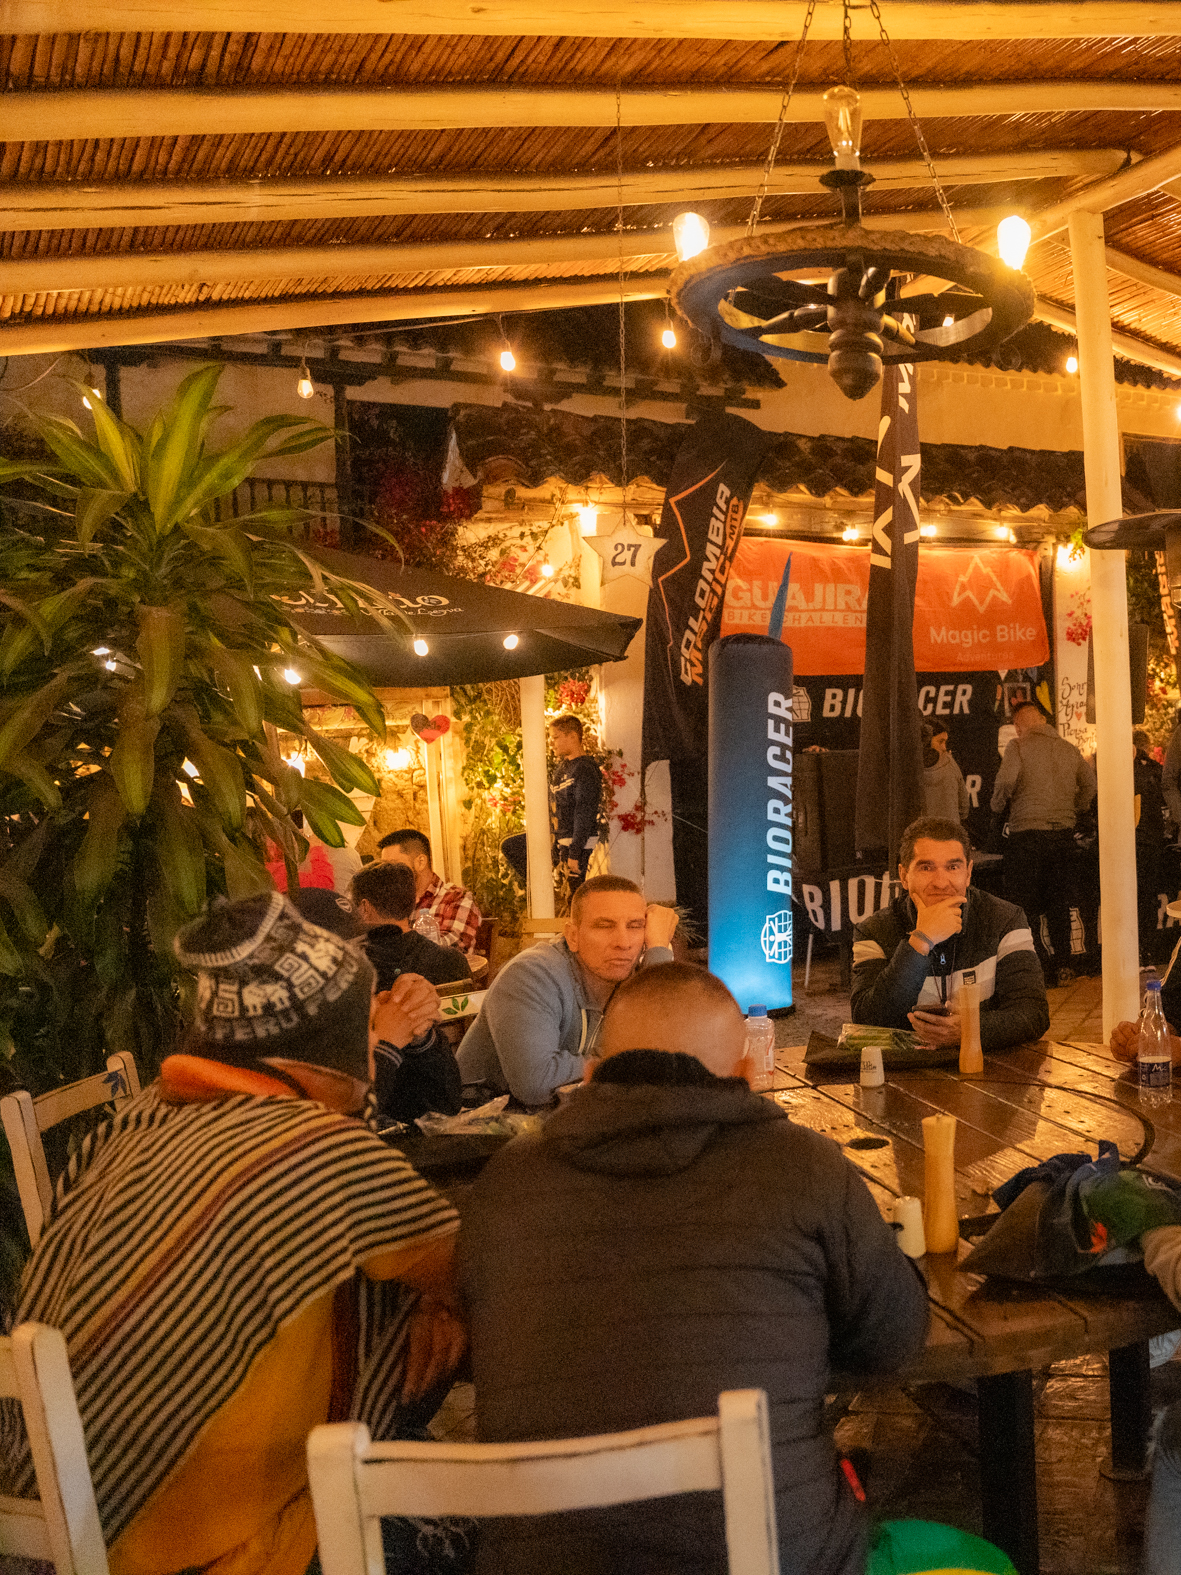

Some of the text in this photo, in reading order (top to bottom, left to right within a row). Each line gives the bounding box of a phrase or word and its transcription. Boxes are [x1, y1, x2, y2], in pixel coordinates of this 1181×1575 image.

[611, 542, 642, 568] 27
[680, 482, 731, 687] COLOMBIA
[726, 610, 864, 625] BIKE CHALLEN
[929, 623, 1037, 648] Magic Bike
[767, 691, 794, 896] BIORACER
